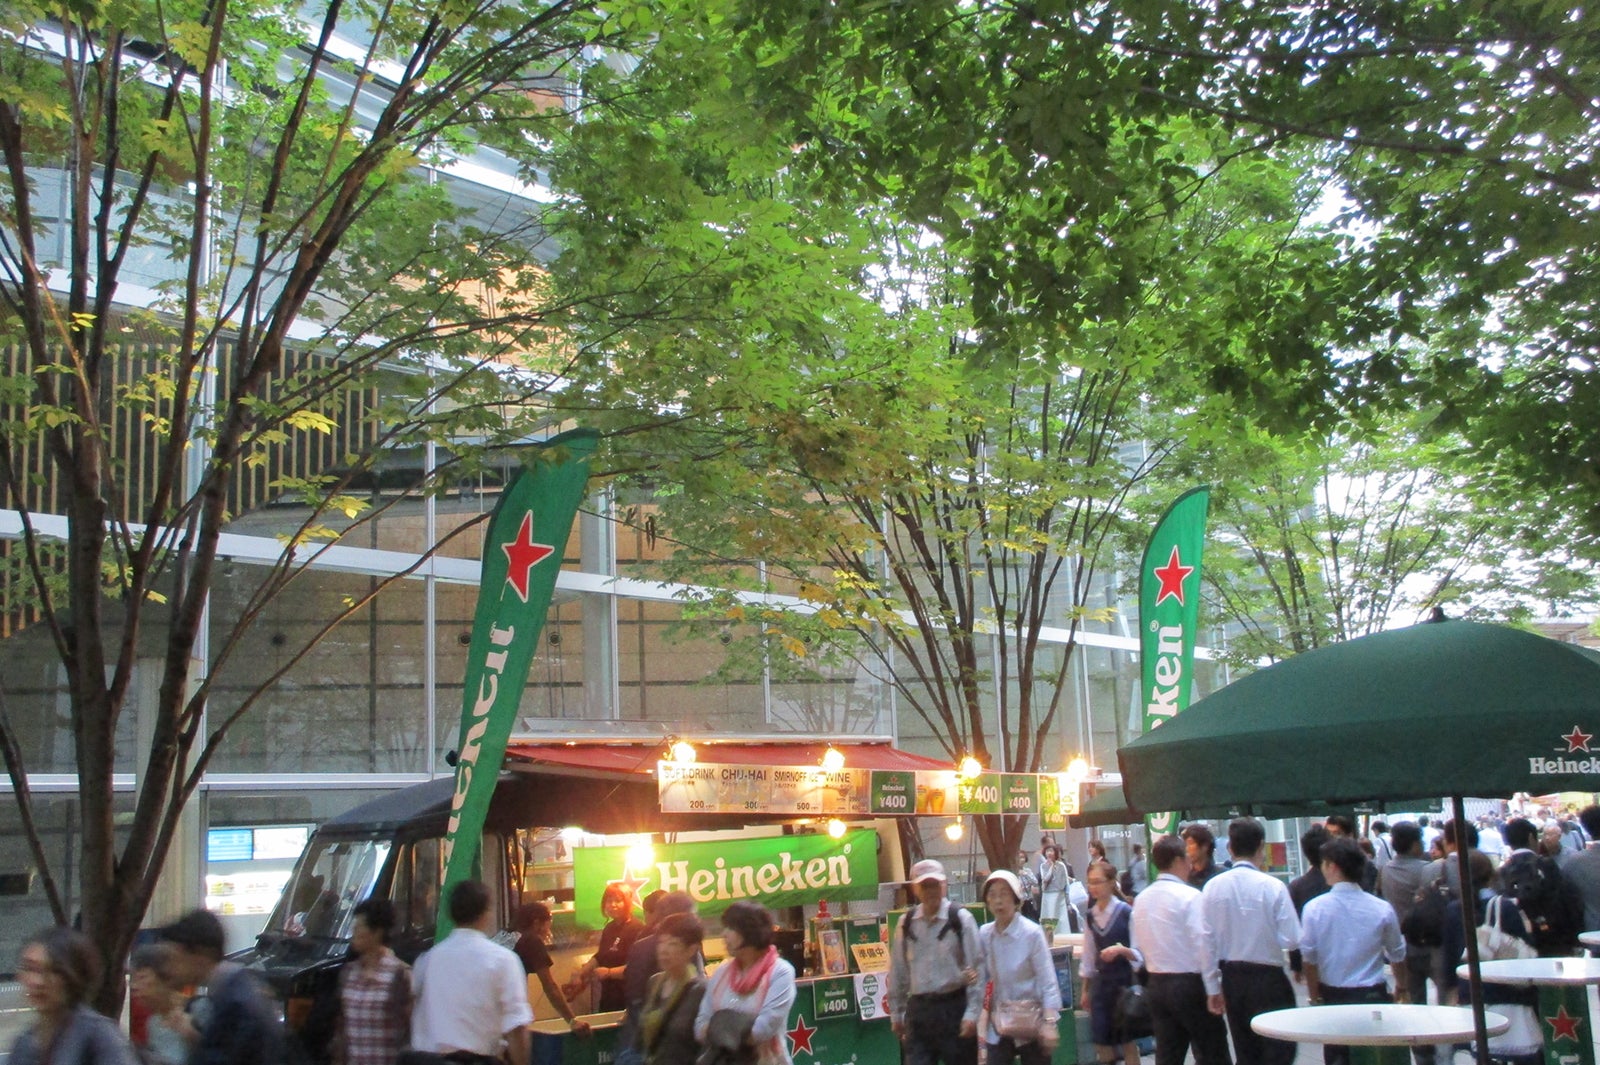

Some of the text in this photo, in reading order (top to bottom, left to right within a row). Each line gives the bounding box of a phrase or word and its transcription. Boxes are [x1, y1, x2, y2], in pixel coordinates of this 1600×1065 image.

[688, 768, 715, 779] DRINK
[721, 768, 767, 780] CHU-HAI
[825, 772, 850, 782] WINE
[689, 800, 704, 808] 200
[796, 802, 810, 810] 500
[880, 795, 907, 808] ¥400
[1008, 796, 1031, 809] ¥400
[655, 852, 852, 902] Heineken
[823, 998, 848, 1012] ¥400
